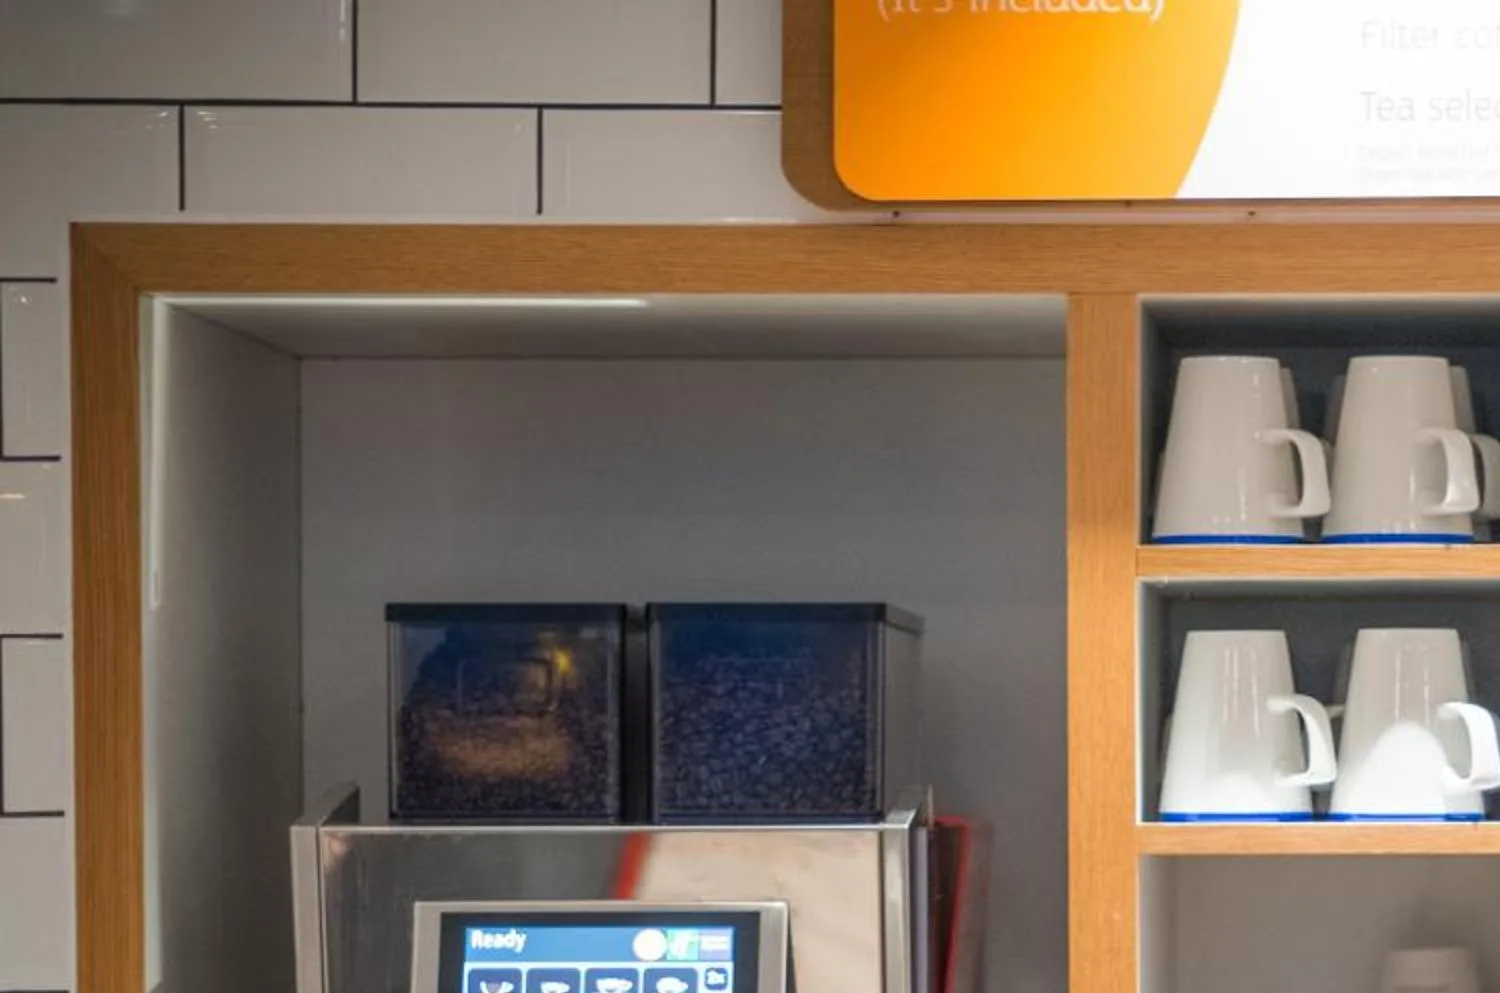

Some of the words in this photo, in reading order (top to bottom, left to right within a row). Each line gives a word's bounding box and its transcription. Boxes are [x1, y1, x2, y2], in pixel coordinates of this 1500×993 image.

[1360, 18, 1440, 50] Filter
[1359, 90, 1415, 122] Tea
[471, 930, 526, 952] Ready
